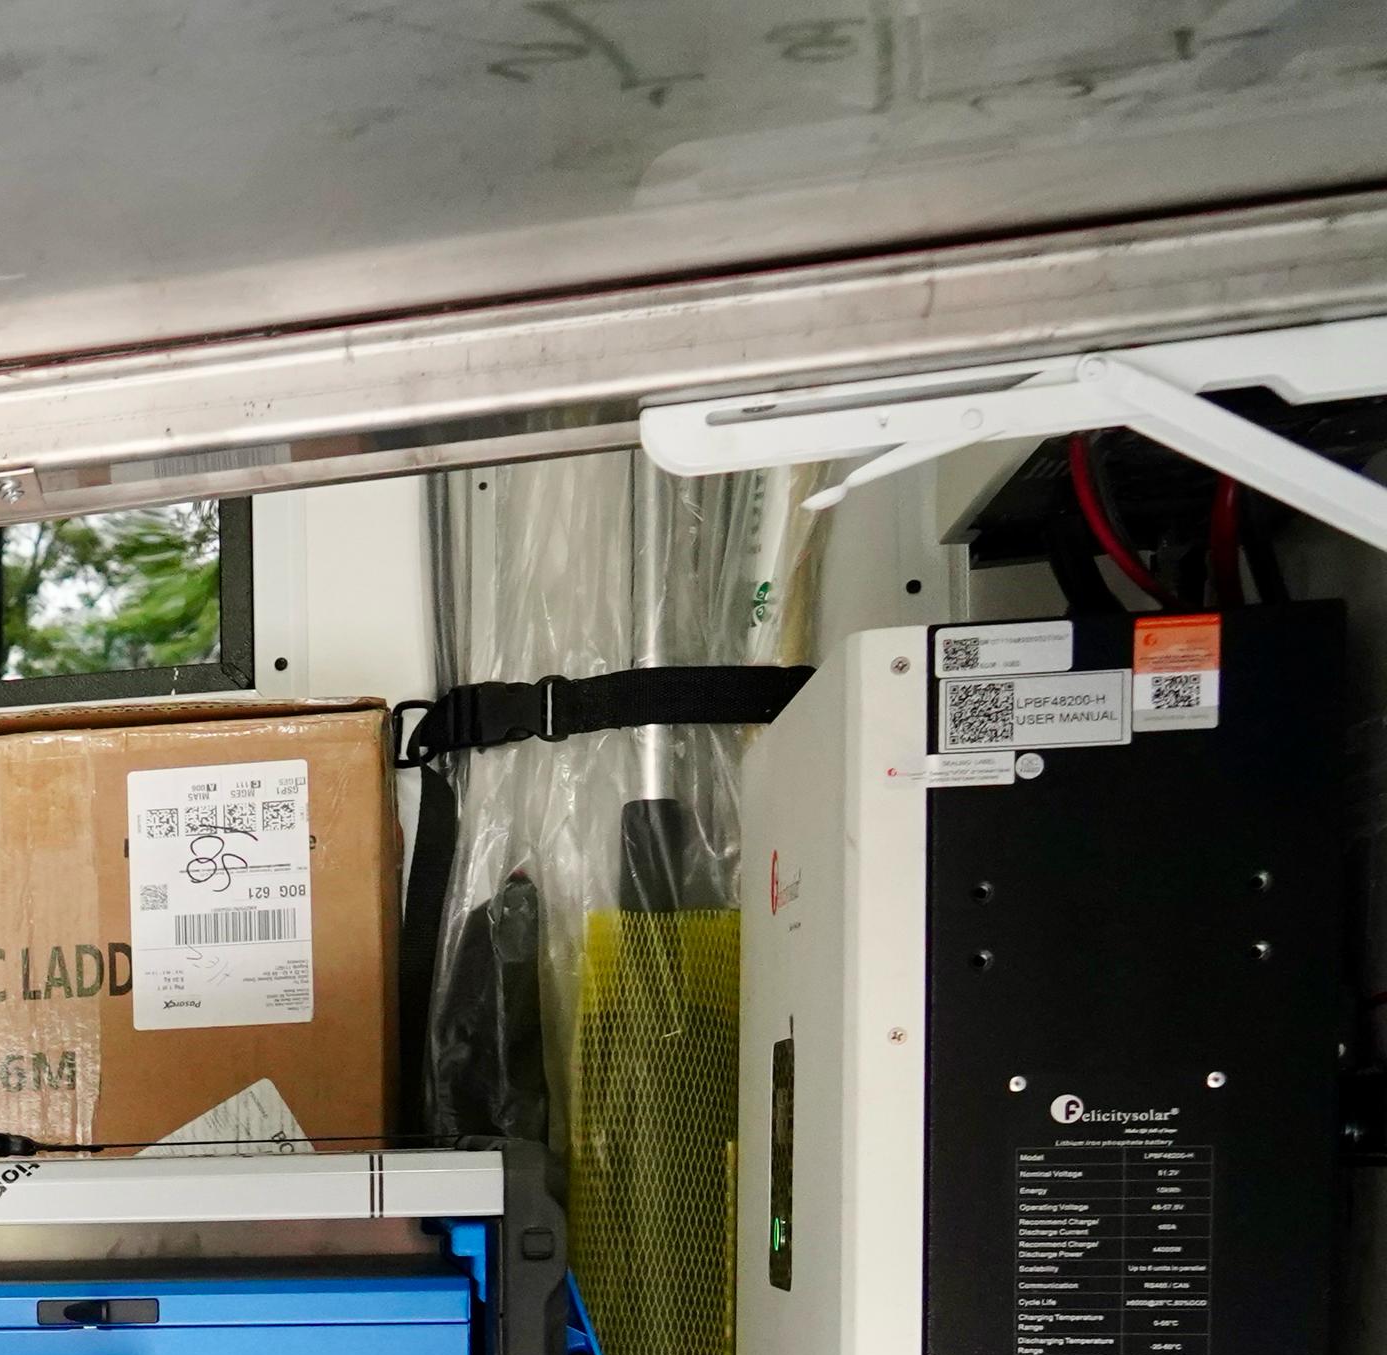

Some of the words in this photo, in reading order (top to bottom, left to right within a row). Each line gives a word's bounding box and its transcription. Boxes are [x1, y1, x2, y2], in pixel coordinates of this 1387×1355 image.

[1015, 712, 1055, 726] USER
[1058, 710, 1119, 724] MANUAL
[248, 886, 270, 899] 621
[279, 883, 307, 897] BOG
[1053, 1170, 1083, 1179] Voltage
[1019, 1187, 1048, 1195] Energy
[1019, 1203, 1058, 1212] Operating
[1058, 1203, 1089, 1212] Voltage
[1018, 1218, 1067, 1226] Recommend
[1018, 1228, 1058, 1236] Discharge
[1059, 1228, 1089, 1236] Current
[1018, 1240, 1067, 1248] Recommend
[1018, 1250, 1058, 1259] Discharge
[1058, 1250, 1084, 1258] Power
[1018, 1281, 1079, 1289] Communication
[1018, 1298, 1041, 1307] Cycle
[1041, 1298, 1057, 1306] Life
[1018, 1313, 1054, 1322] Charging
[1054, 1313, 1105, 1322] Temperature
[1018, 1323, 1044, 1332] Range
[1017, 1337, 1065, 1346] Discharging
[1065, 1337, 1115, 1345] Temperature
[1017, 1346, 1044, 1355] Range
